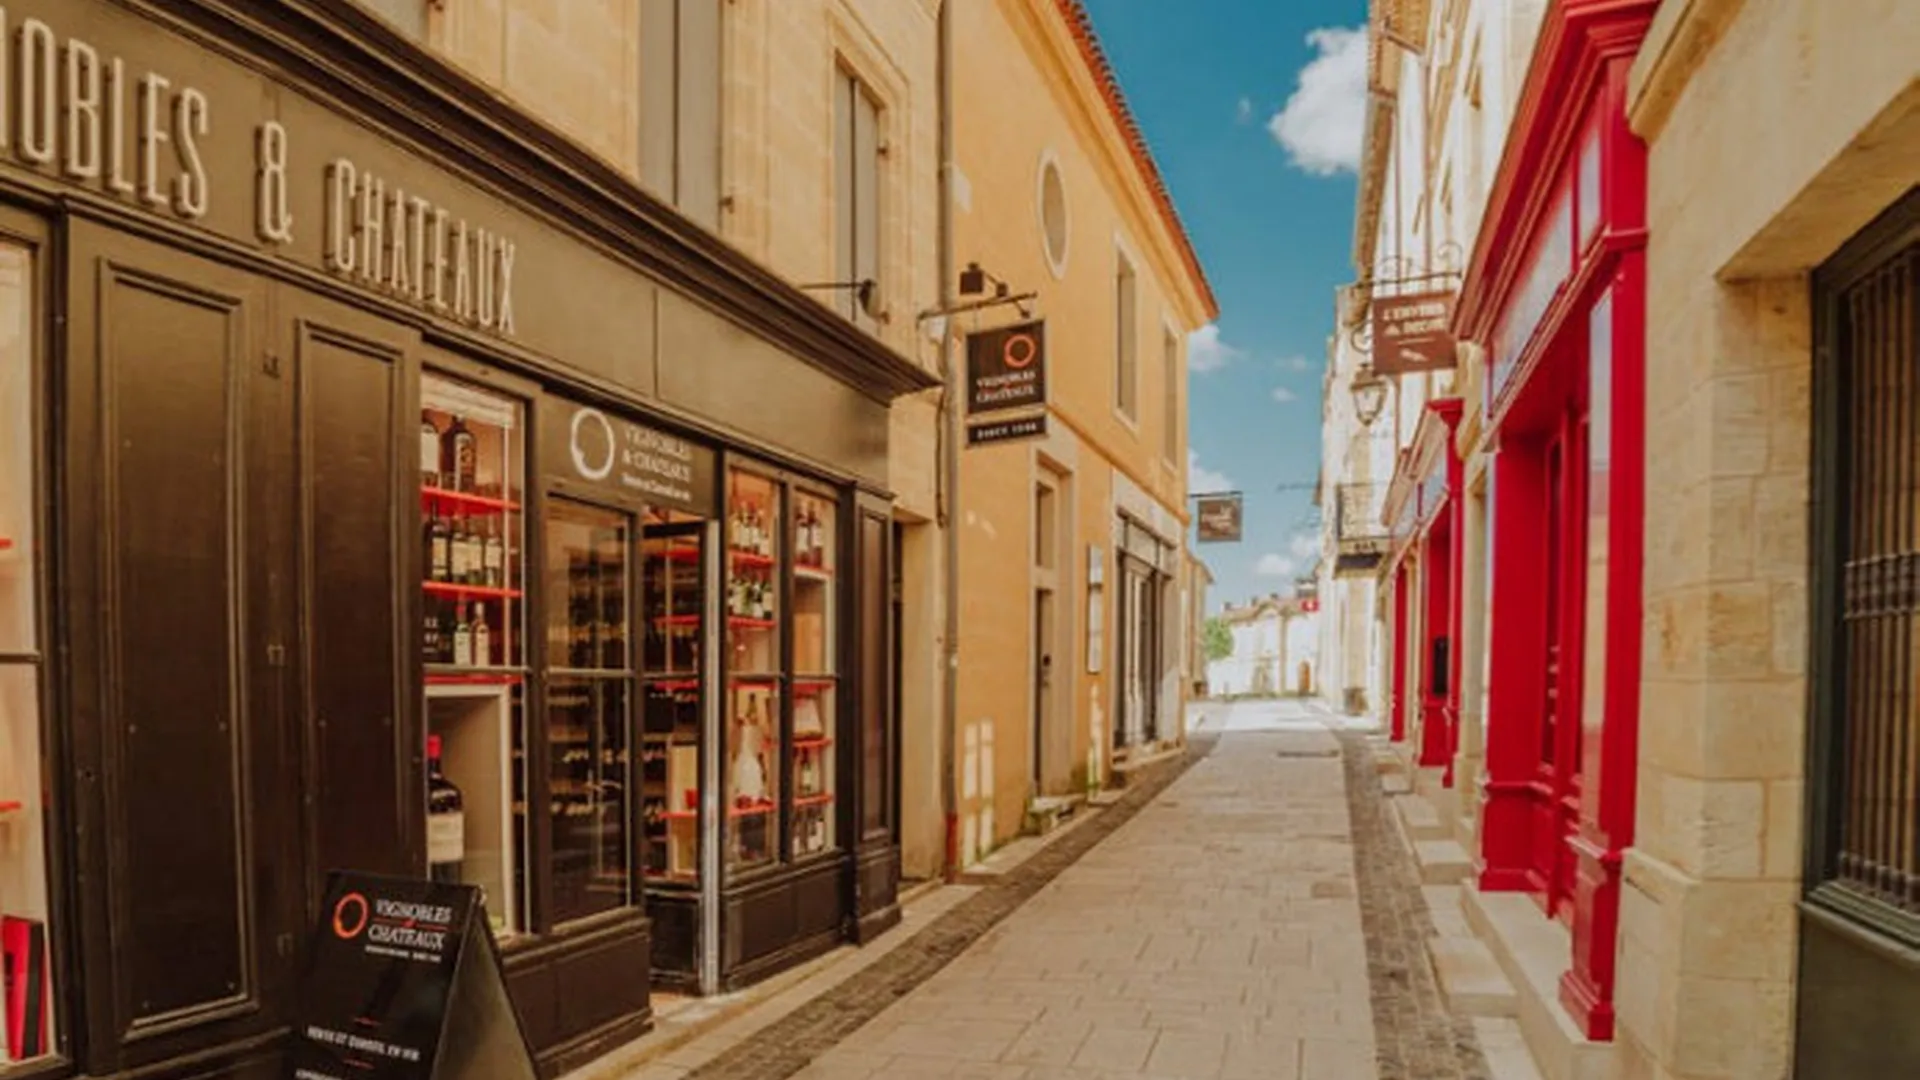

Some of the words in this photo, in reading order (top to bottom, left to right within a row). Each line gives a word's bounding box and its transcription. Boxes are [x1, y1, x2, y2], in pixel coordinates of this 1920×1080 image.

[0, 4, 208, 218] OBLES
[260, 119, 293, 245] &
[331, 157, 515, 336] CHATEAUX
[376, 899, 453, 923] VIGNOBLES
[368, 924, 446, 950] CHATEAUX
